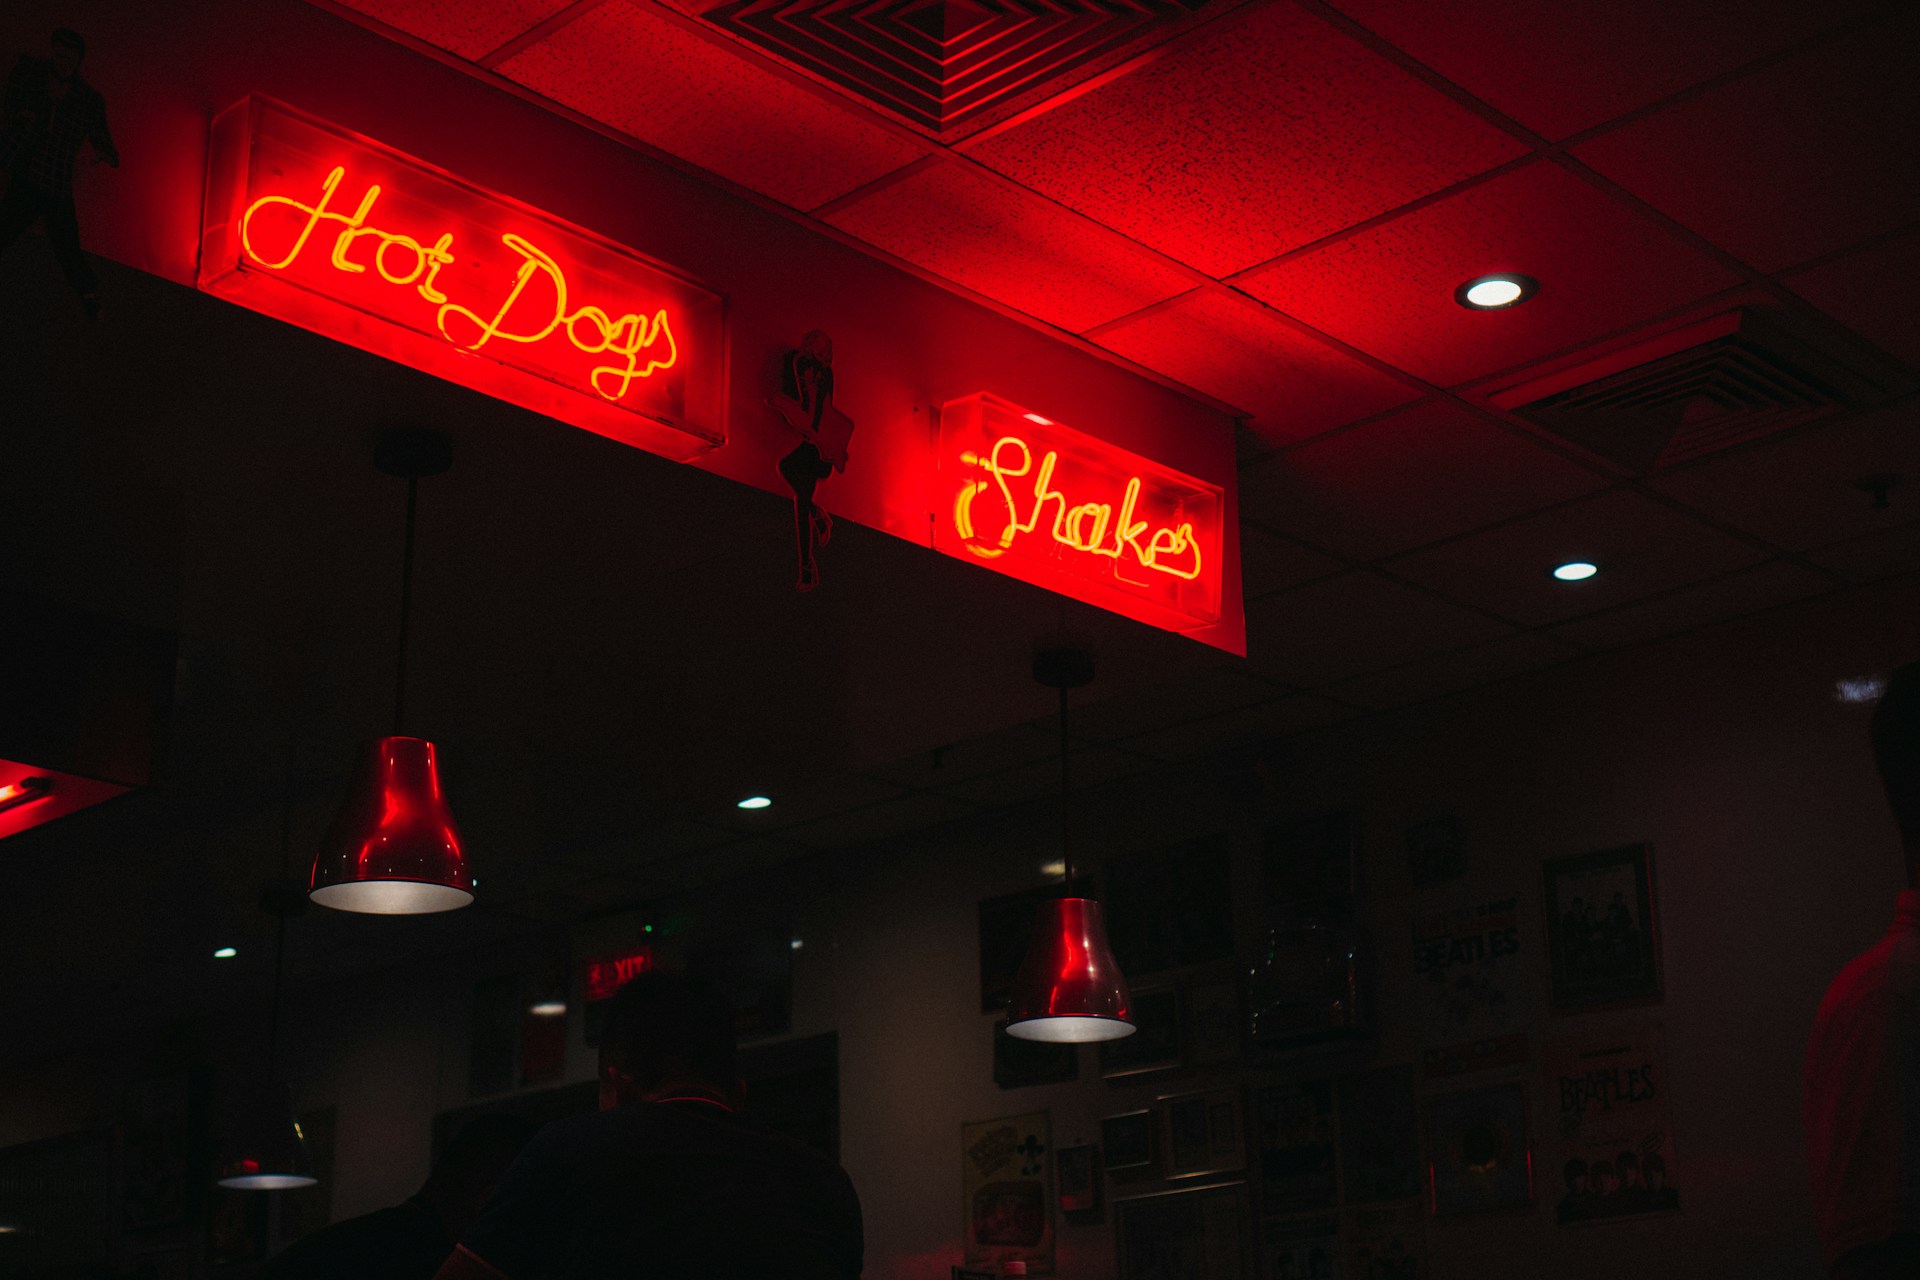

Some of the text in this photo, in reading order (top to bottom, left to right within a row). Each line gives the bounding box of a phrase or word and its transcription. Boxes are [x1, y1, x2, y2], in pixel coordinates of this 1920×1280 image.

[241, 166, 677, 401] Hot Dogs
[955, 436, 1201, 580] Shakes
[1558, 1063, 1656, 1114] BEATLES
